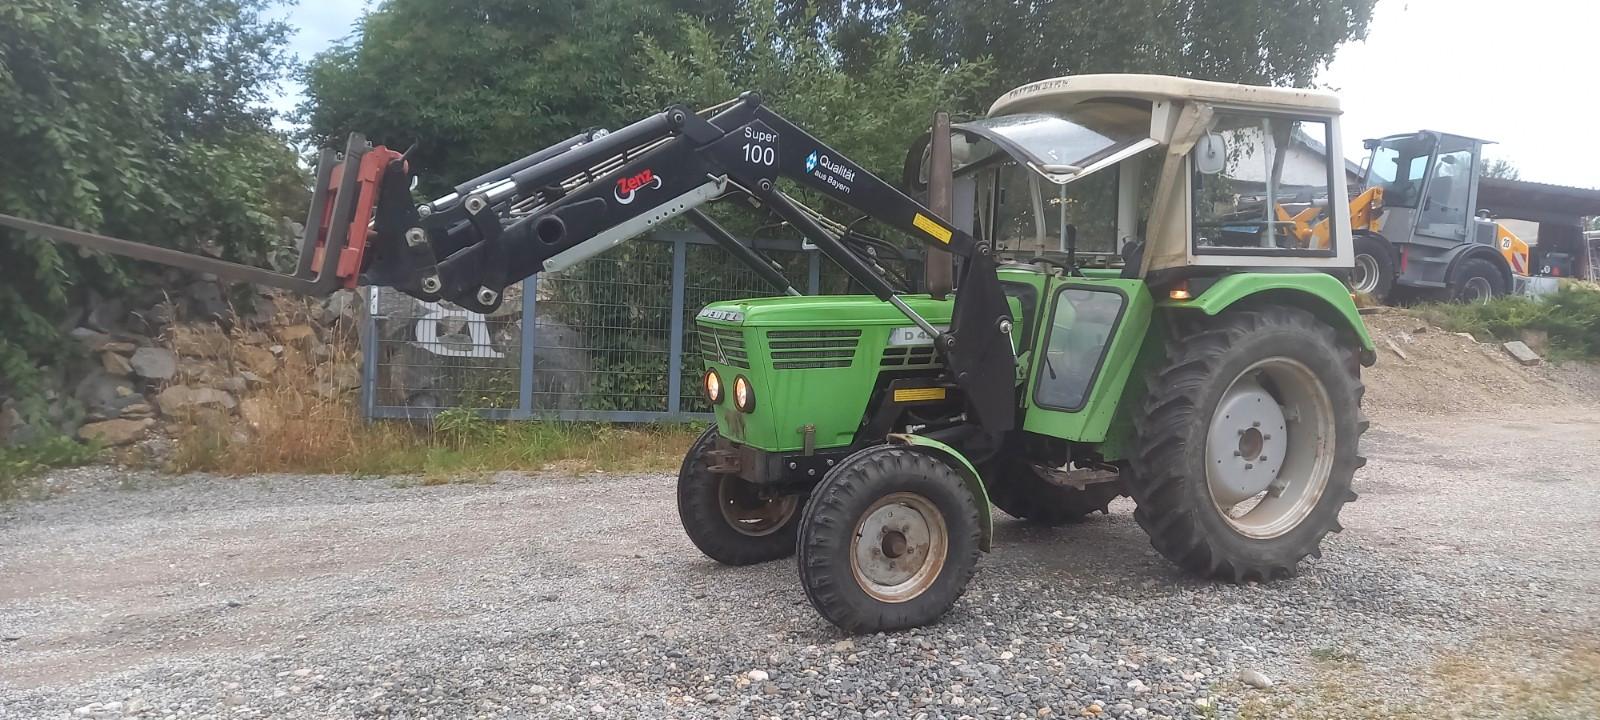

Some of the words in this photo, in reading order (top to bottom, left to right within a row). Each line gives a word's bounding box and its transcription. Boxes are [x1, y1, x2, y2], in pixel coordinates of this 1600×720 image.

[744, 126, 777, 143] Super
[742, 143, 775, 166] 100
[819, 154, 856, 182] Qualität
[616, 168, 654, 194] Zenz
[814, 168, 827, 181] aus
[827, 175, 851, 194] Bayern
[904, 331, 914, 341] D
